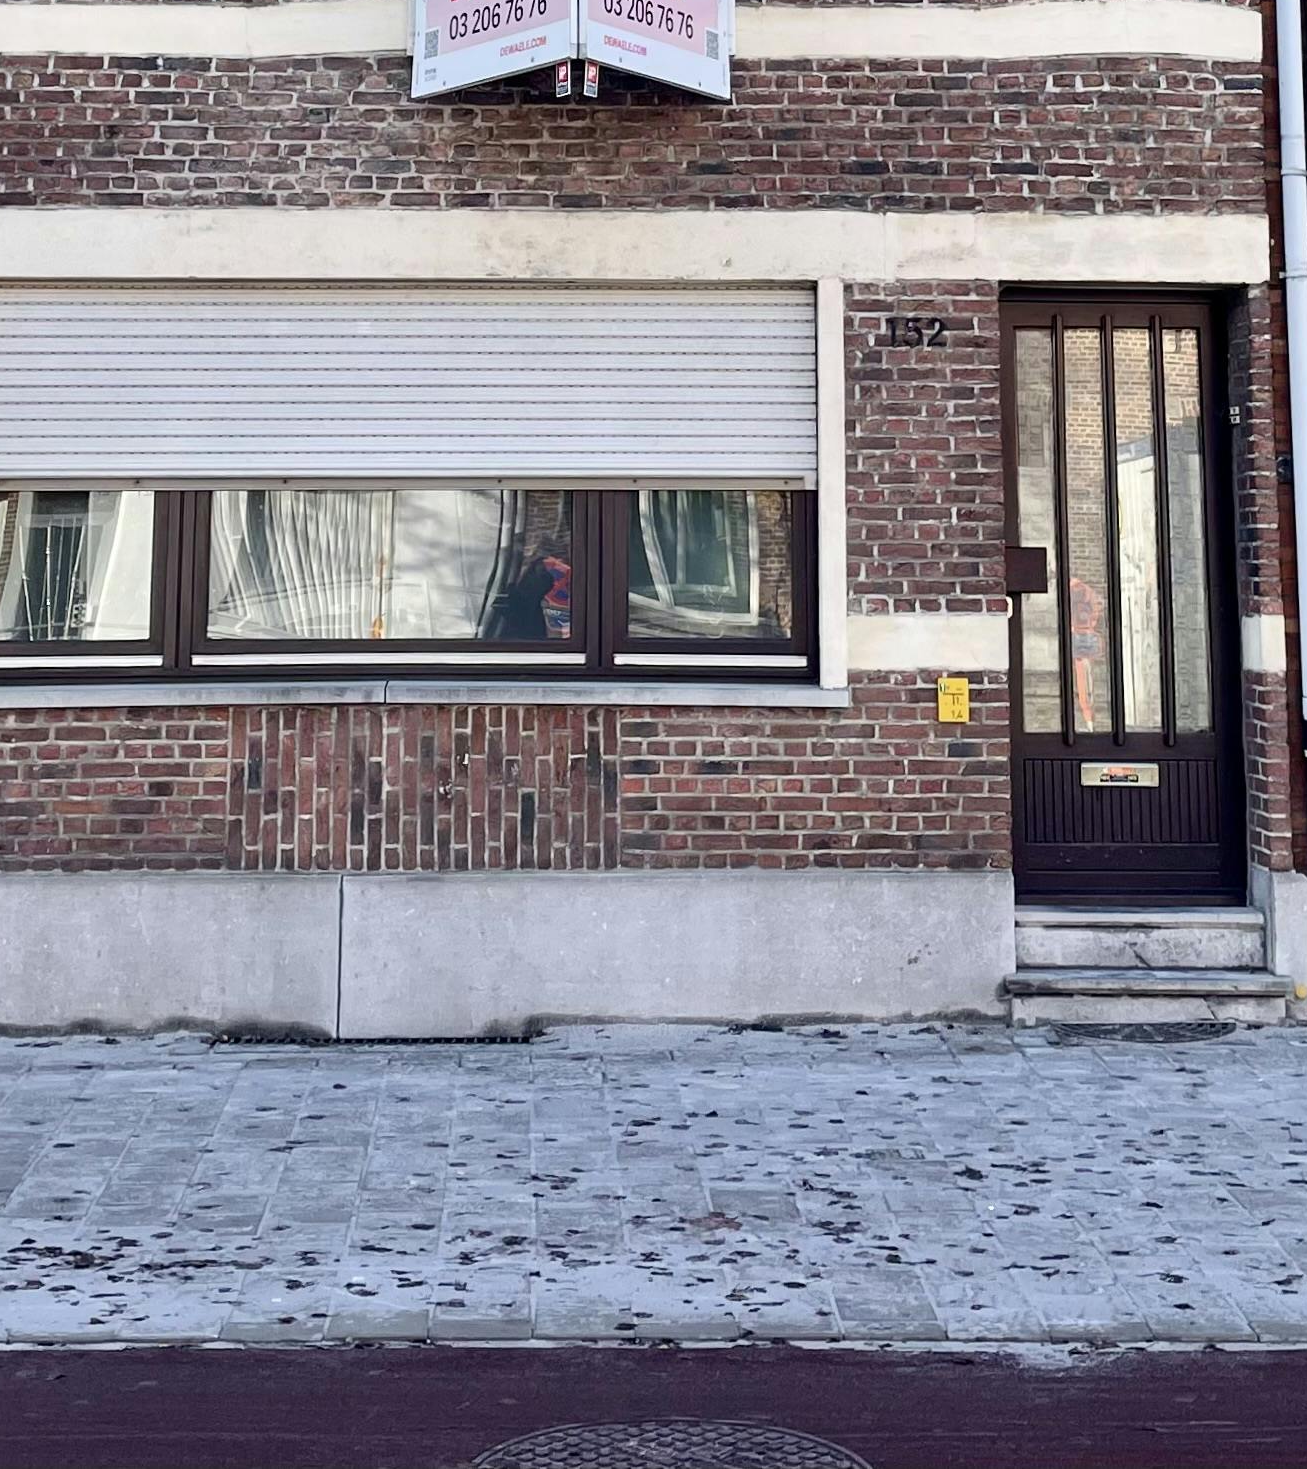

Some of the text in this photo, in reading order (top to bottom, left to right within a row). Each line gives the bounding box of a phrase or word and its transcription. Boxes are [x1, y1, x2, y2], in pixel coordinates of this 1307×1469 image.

[449, 11, 468, 41] 03
[471, 2, 501, 35] 206
[657, 4, 675, 33] 76
[677, 11, 694, 40] 76
[885, 316, 947, 348] 152
